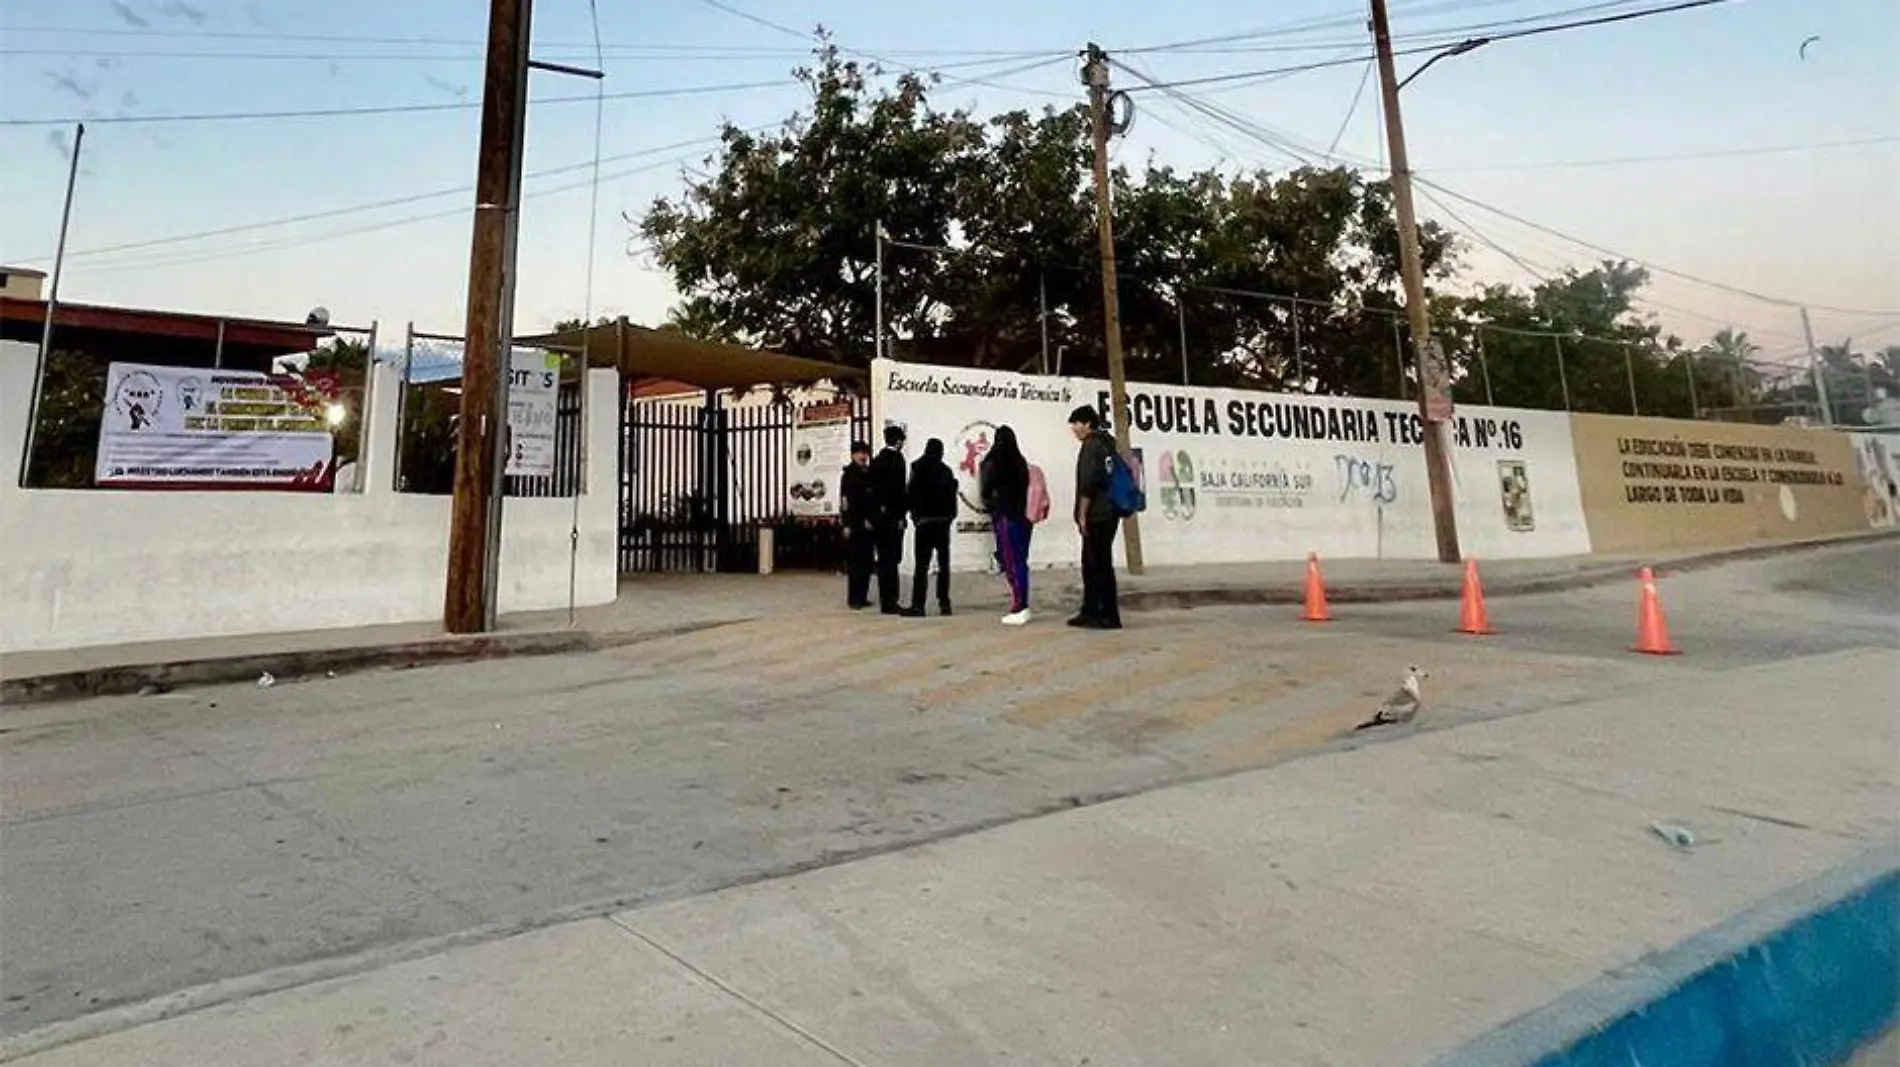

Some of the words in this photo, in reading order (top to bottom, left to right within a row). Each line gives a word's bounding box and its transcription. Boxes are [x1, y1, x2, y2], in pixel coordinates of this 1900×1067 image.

[887, 371, 938, 393] Escuela
[941, 377, 1017, 399] Secundaria
[1227, 400, 1379, 443] SECUNDARIA
[1200, 470, 1227, 488] BAJA
[1626, 485, 1661, 503] LARGO
[1664, 486, 1678, 503] DE
